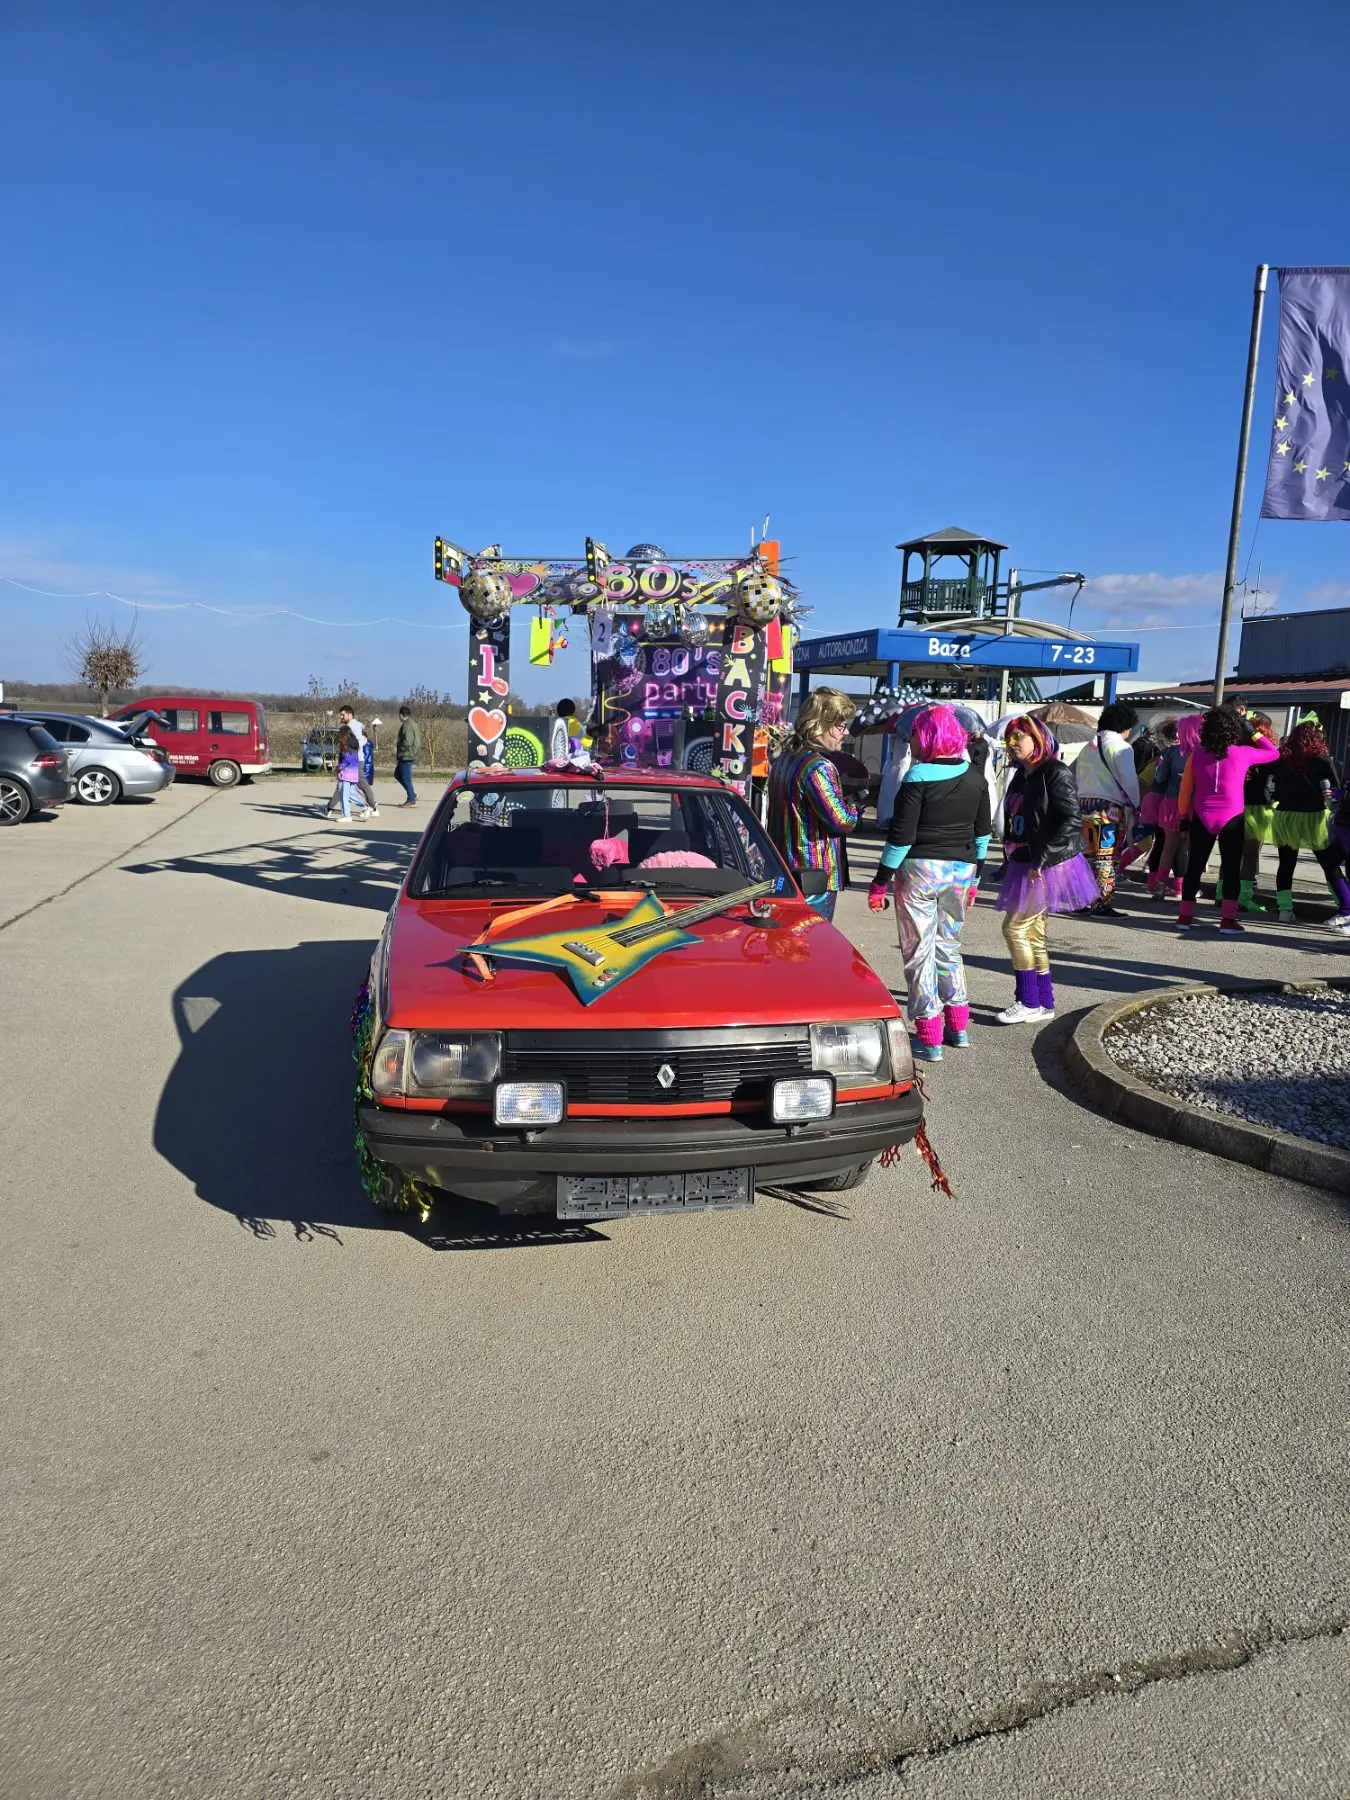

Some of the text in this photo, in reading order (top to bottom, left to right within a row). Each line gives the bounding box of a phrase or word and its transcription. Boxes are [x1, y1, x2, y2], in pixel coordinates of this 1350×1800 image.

[597, 623, 606, 642] 2
[477, 644, 498, 686] I
[928, 638, 1095, 664] Baza 7-23
[646, 676, 718, 709] party
[722, 625, 755, 753] BACK
[720, 757, 744, 775] TO
